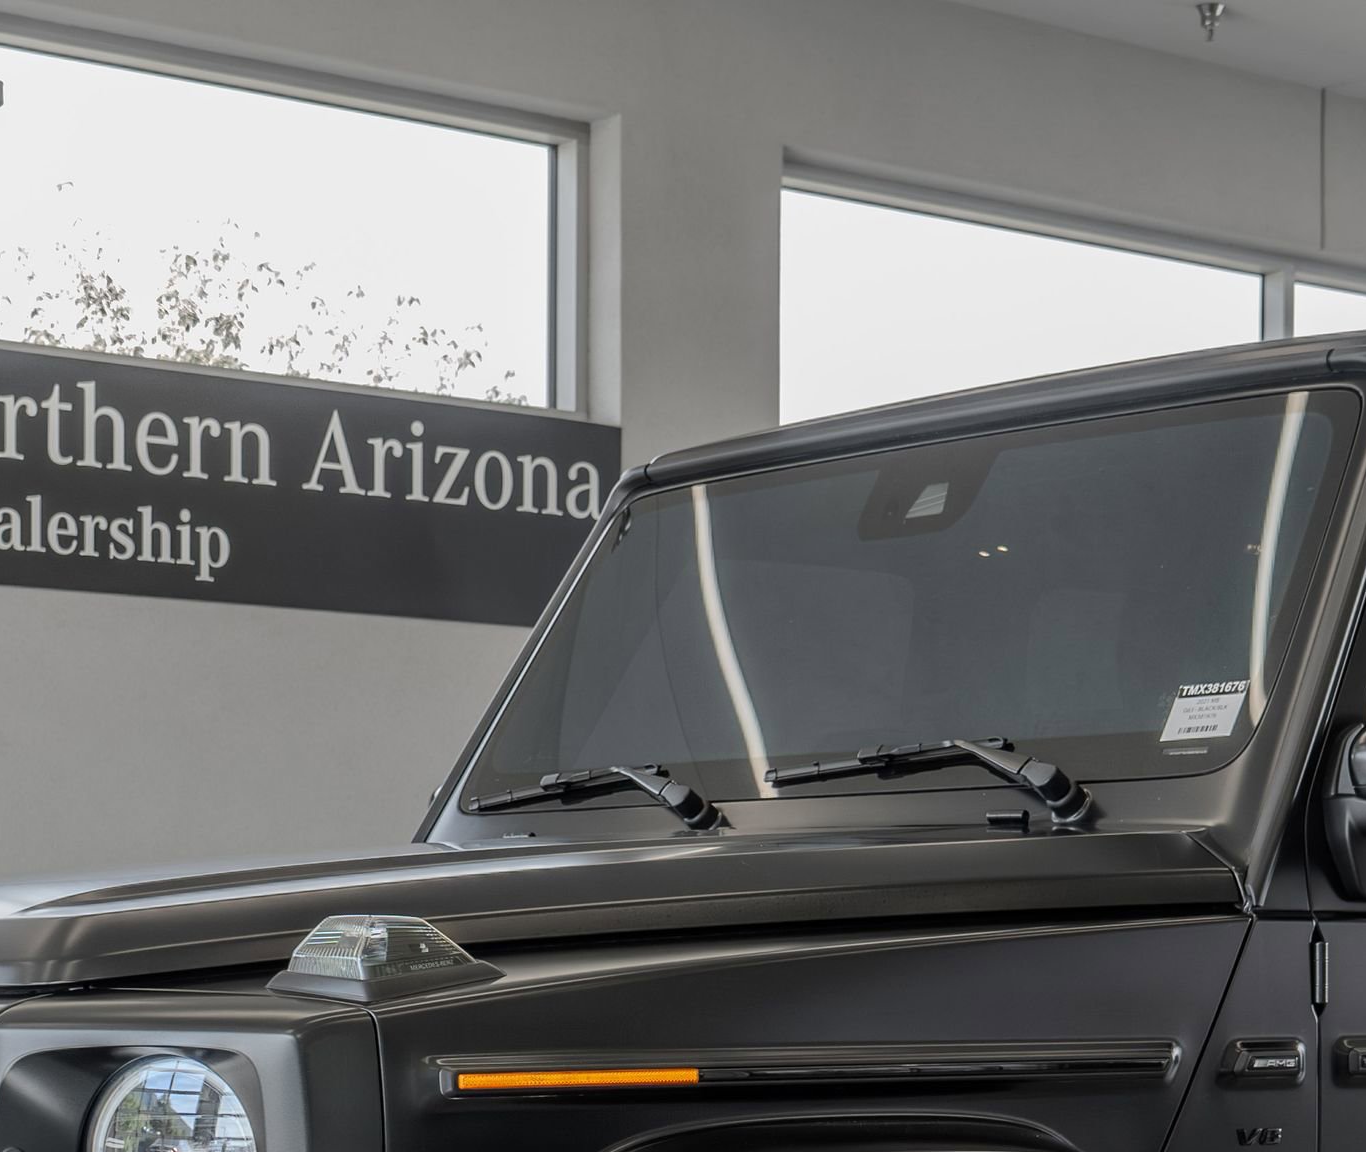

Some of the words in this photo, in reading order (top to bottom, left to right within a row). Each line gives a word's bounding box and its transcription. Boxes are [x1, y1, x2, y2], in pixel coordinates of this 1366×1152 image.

[301, 409, 601, 521] Arizona
[1182, 681, 1245, 696] TMX381676
[1266, 1058, 1297, 1068] AMG
